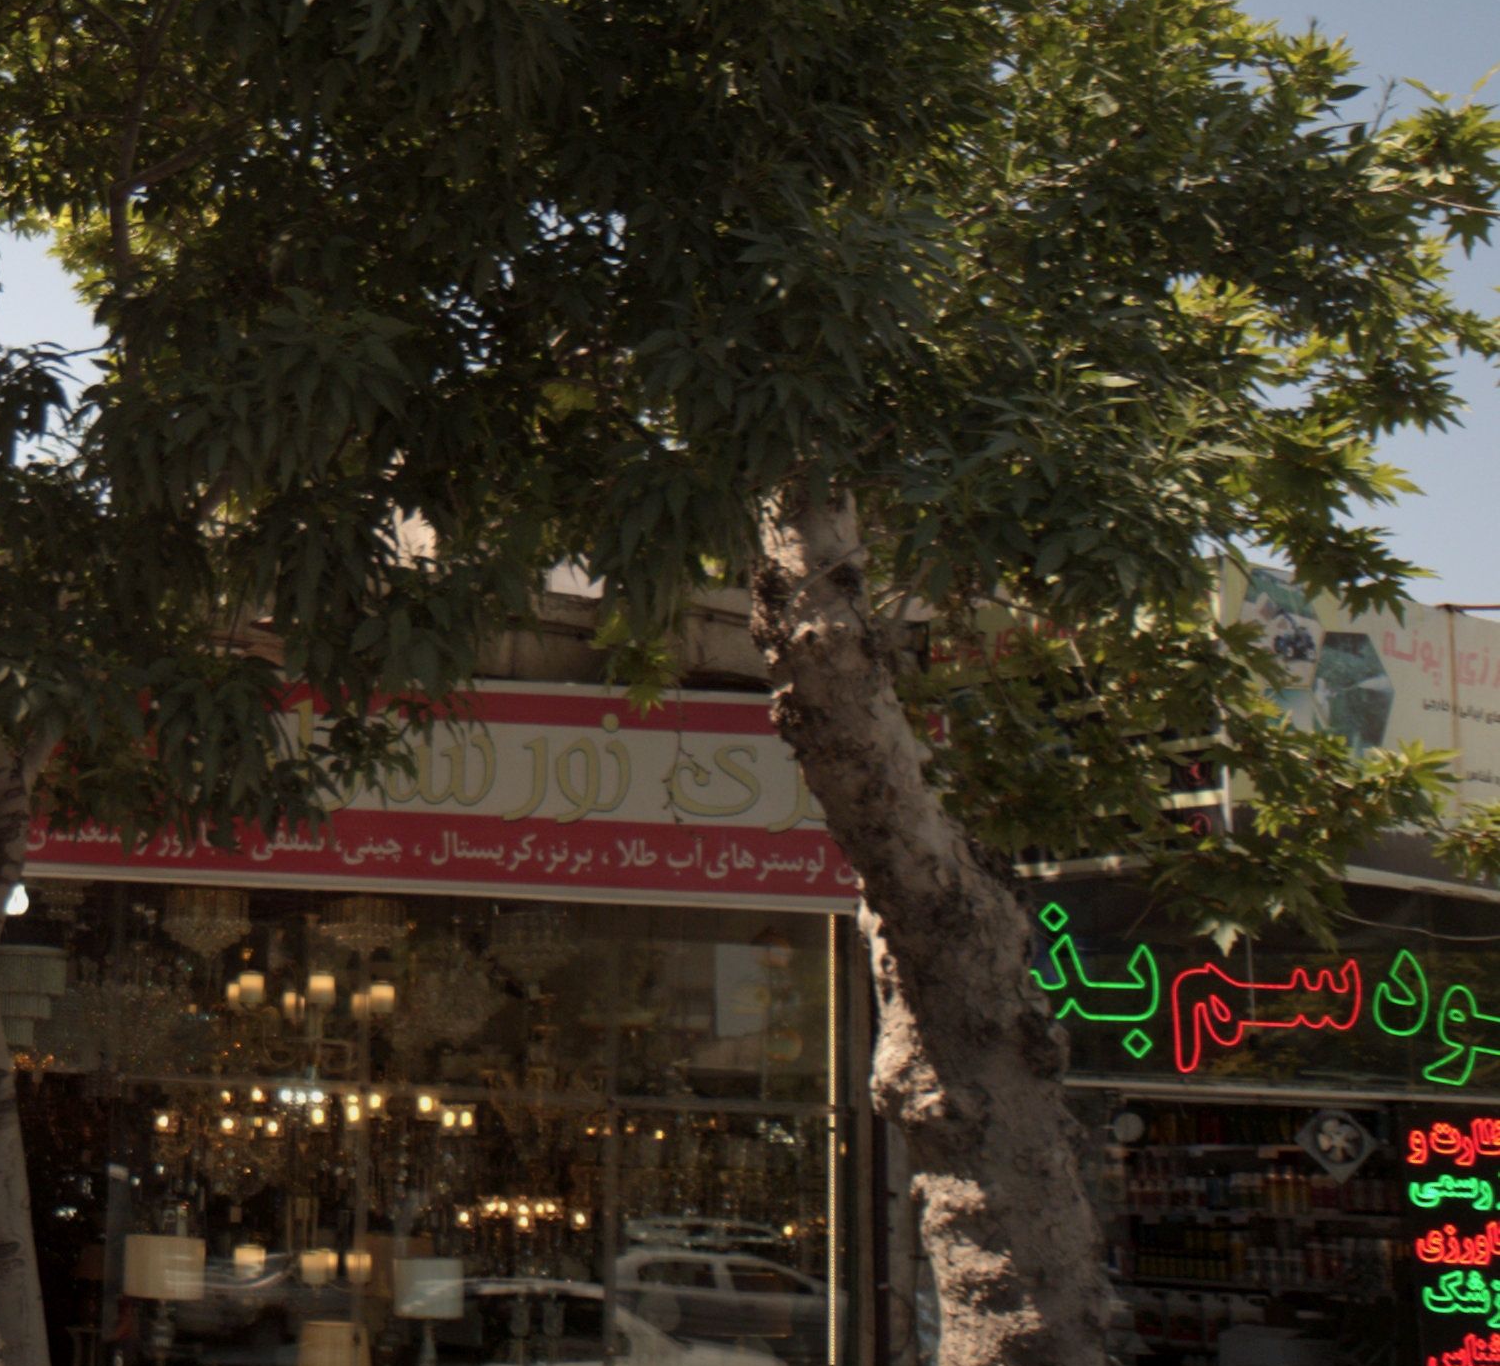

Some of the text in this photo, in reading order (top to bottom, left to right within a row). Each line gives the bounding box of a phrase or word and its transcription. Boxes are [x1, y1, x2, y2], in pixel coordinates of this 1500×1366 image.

[616, 839, 658, 867] طلا
[705, 842, 826, 883] لوسترهای
[1172, 958, 1362, 1073] سم
[1408, 1174, 1493, 1211] رسمی
